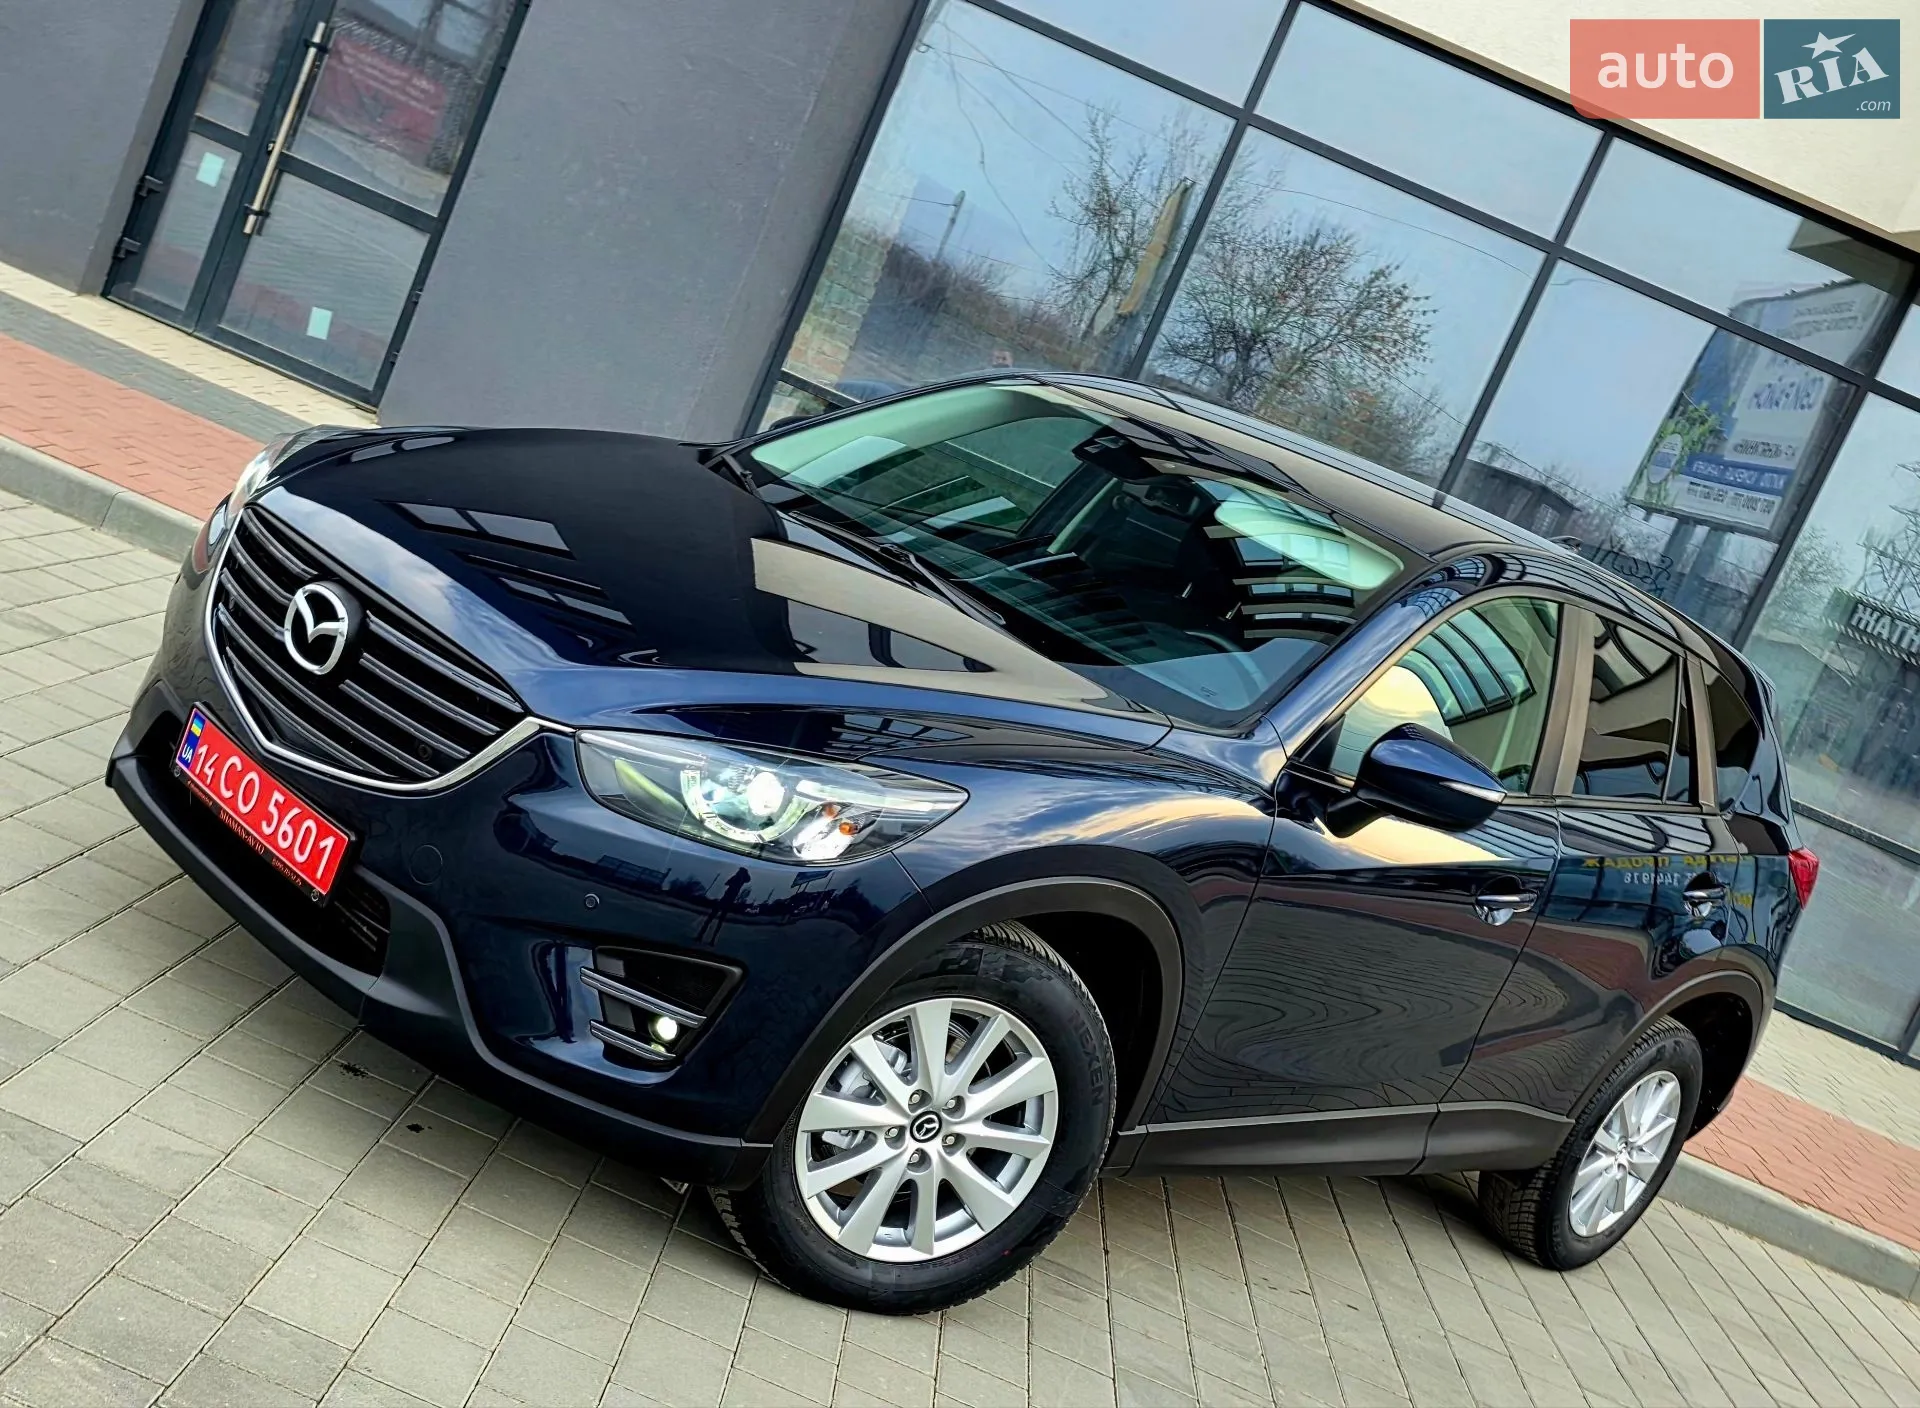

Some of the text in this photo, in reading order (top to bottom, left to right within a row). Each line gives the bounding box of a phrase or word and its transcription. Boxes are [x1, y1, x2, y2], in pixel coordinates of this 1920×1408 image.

[181, 744, 194, 763] UA
[261, 790, 336, 879] 5601
[1068, 1010, 1104, 1105] NEXEN
